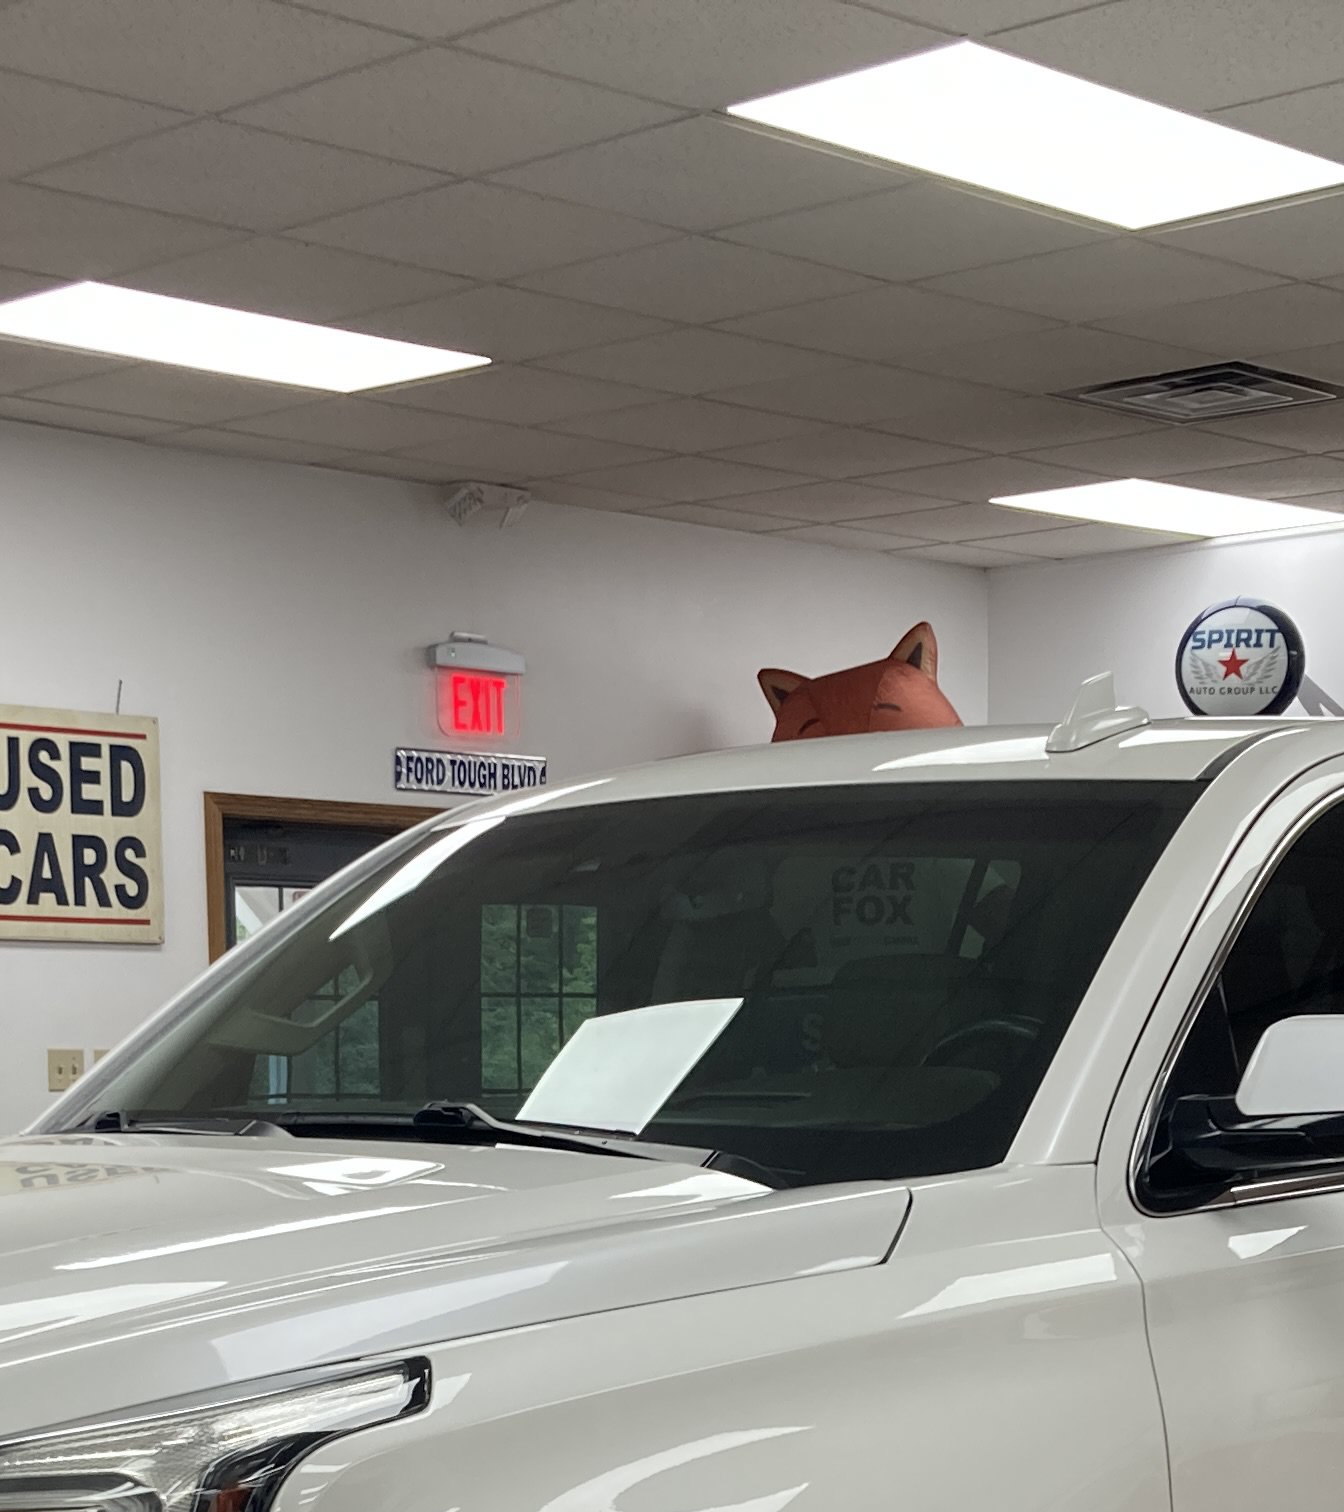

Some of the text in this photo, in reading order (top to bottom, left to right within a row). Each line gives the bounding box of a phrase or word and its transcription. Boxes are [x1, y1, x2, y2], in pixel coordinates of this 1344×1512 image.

[1191, 628, 1280, 650] SPIRIT
[452, 674, 506, 734] EXIT
[1189, 686, 1278, 696] AUTO GROUP LLC
[405, 755, 537, 791] FORD TOUGH BLVD
[831, 862, 916, 892] CAR
[832, 895, 915, 926] FOX
